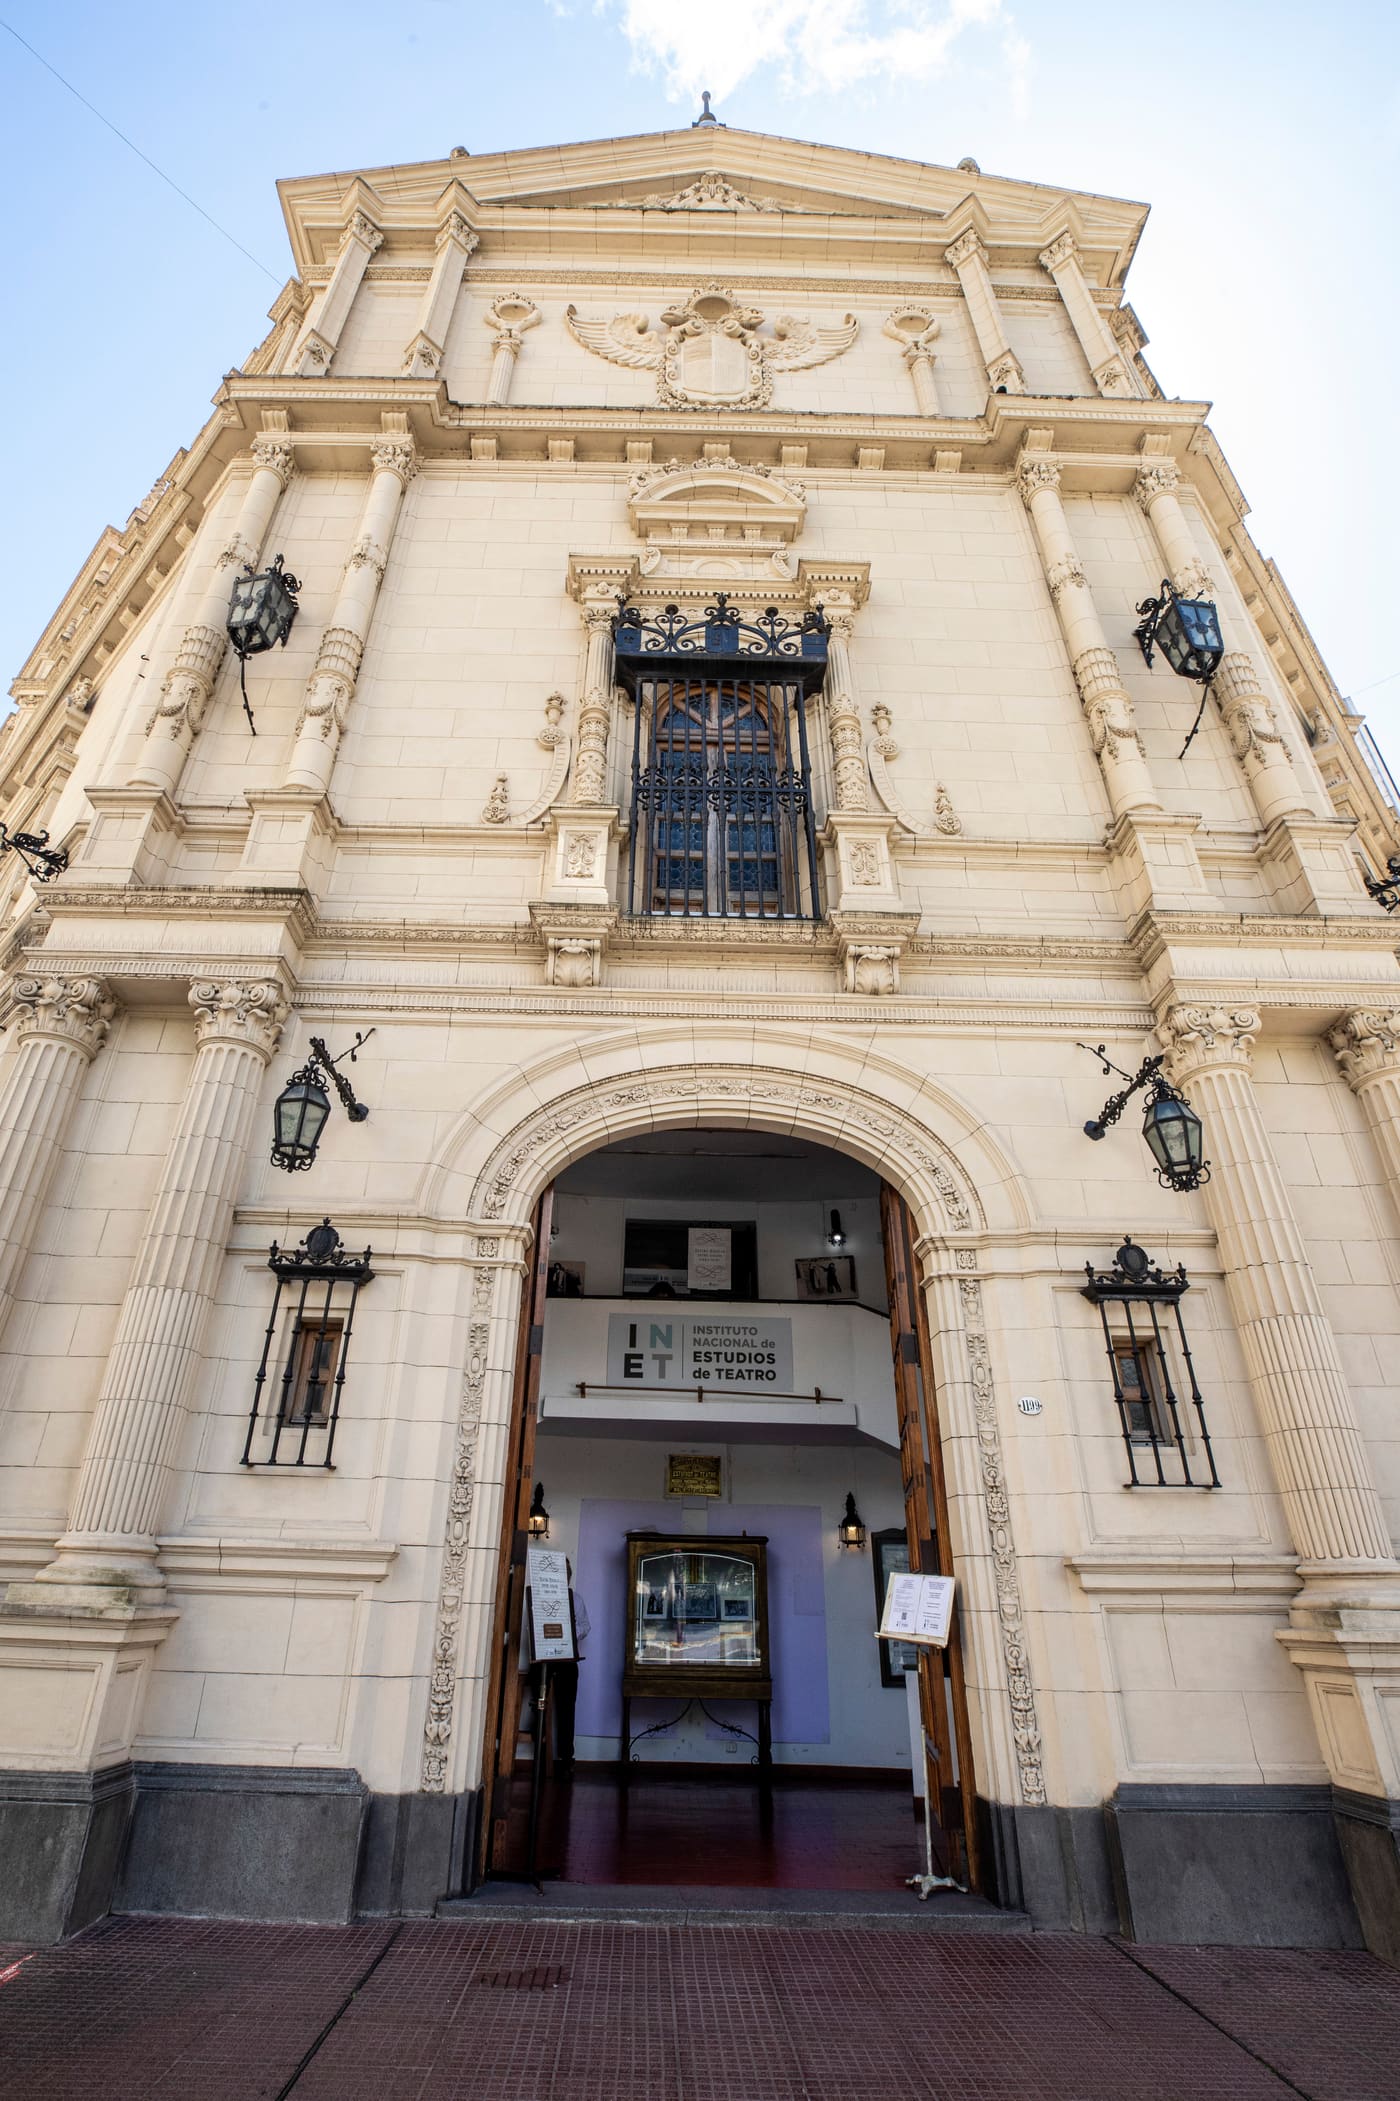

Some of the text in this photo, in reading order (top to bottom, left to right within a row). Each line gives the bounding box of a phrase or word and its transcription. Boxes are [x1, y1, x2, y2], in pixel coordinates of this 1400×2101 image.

[692, 1325, 758, 1336] INSTITUTO
[692, 1337, 776, 1349] NACIONAL de
[692, 1351, 776, 1364] ESTUDIOS
[692, 1368, 777, 1381] de TEATRO
[1021, 1399, 1041, 1412] 1199
